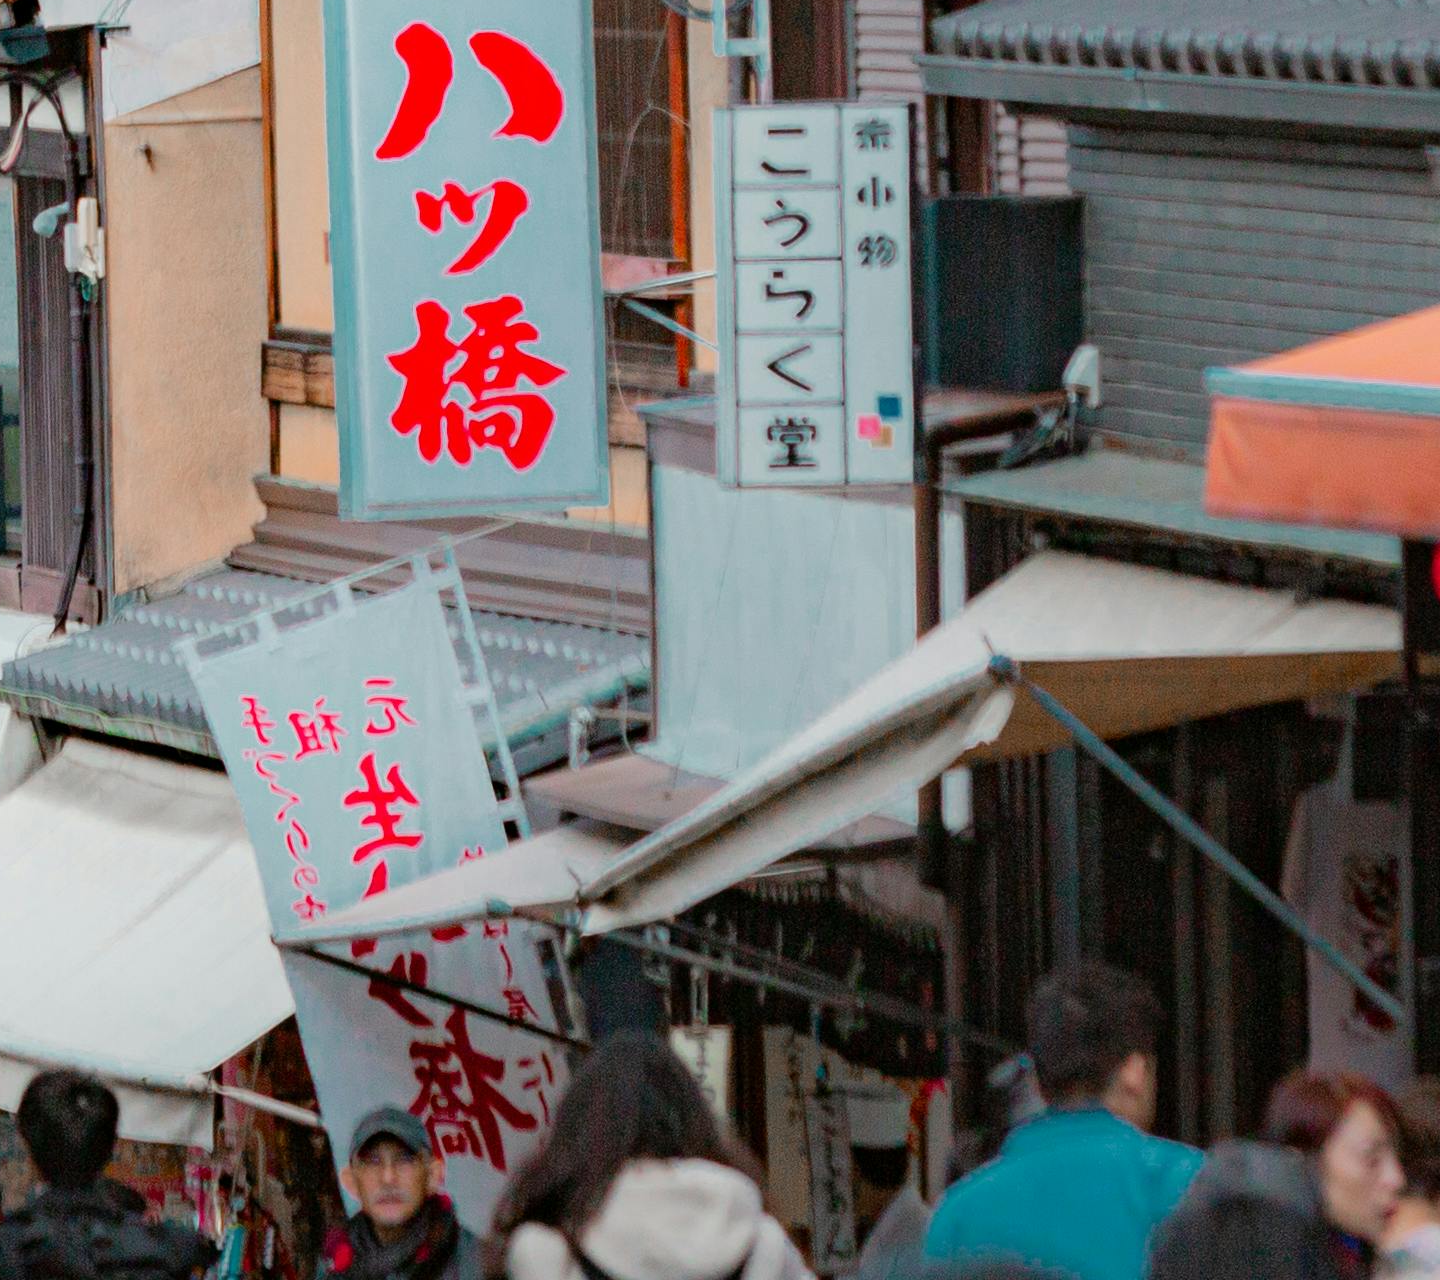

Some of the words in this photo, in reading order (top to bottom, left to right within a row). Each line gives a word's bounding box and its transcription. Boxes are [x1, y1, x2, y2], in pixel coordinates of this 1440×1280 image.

[761, 128, 817, 470] こうらく堂
